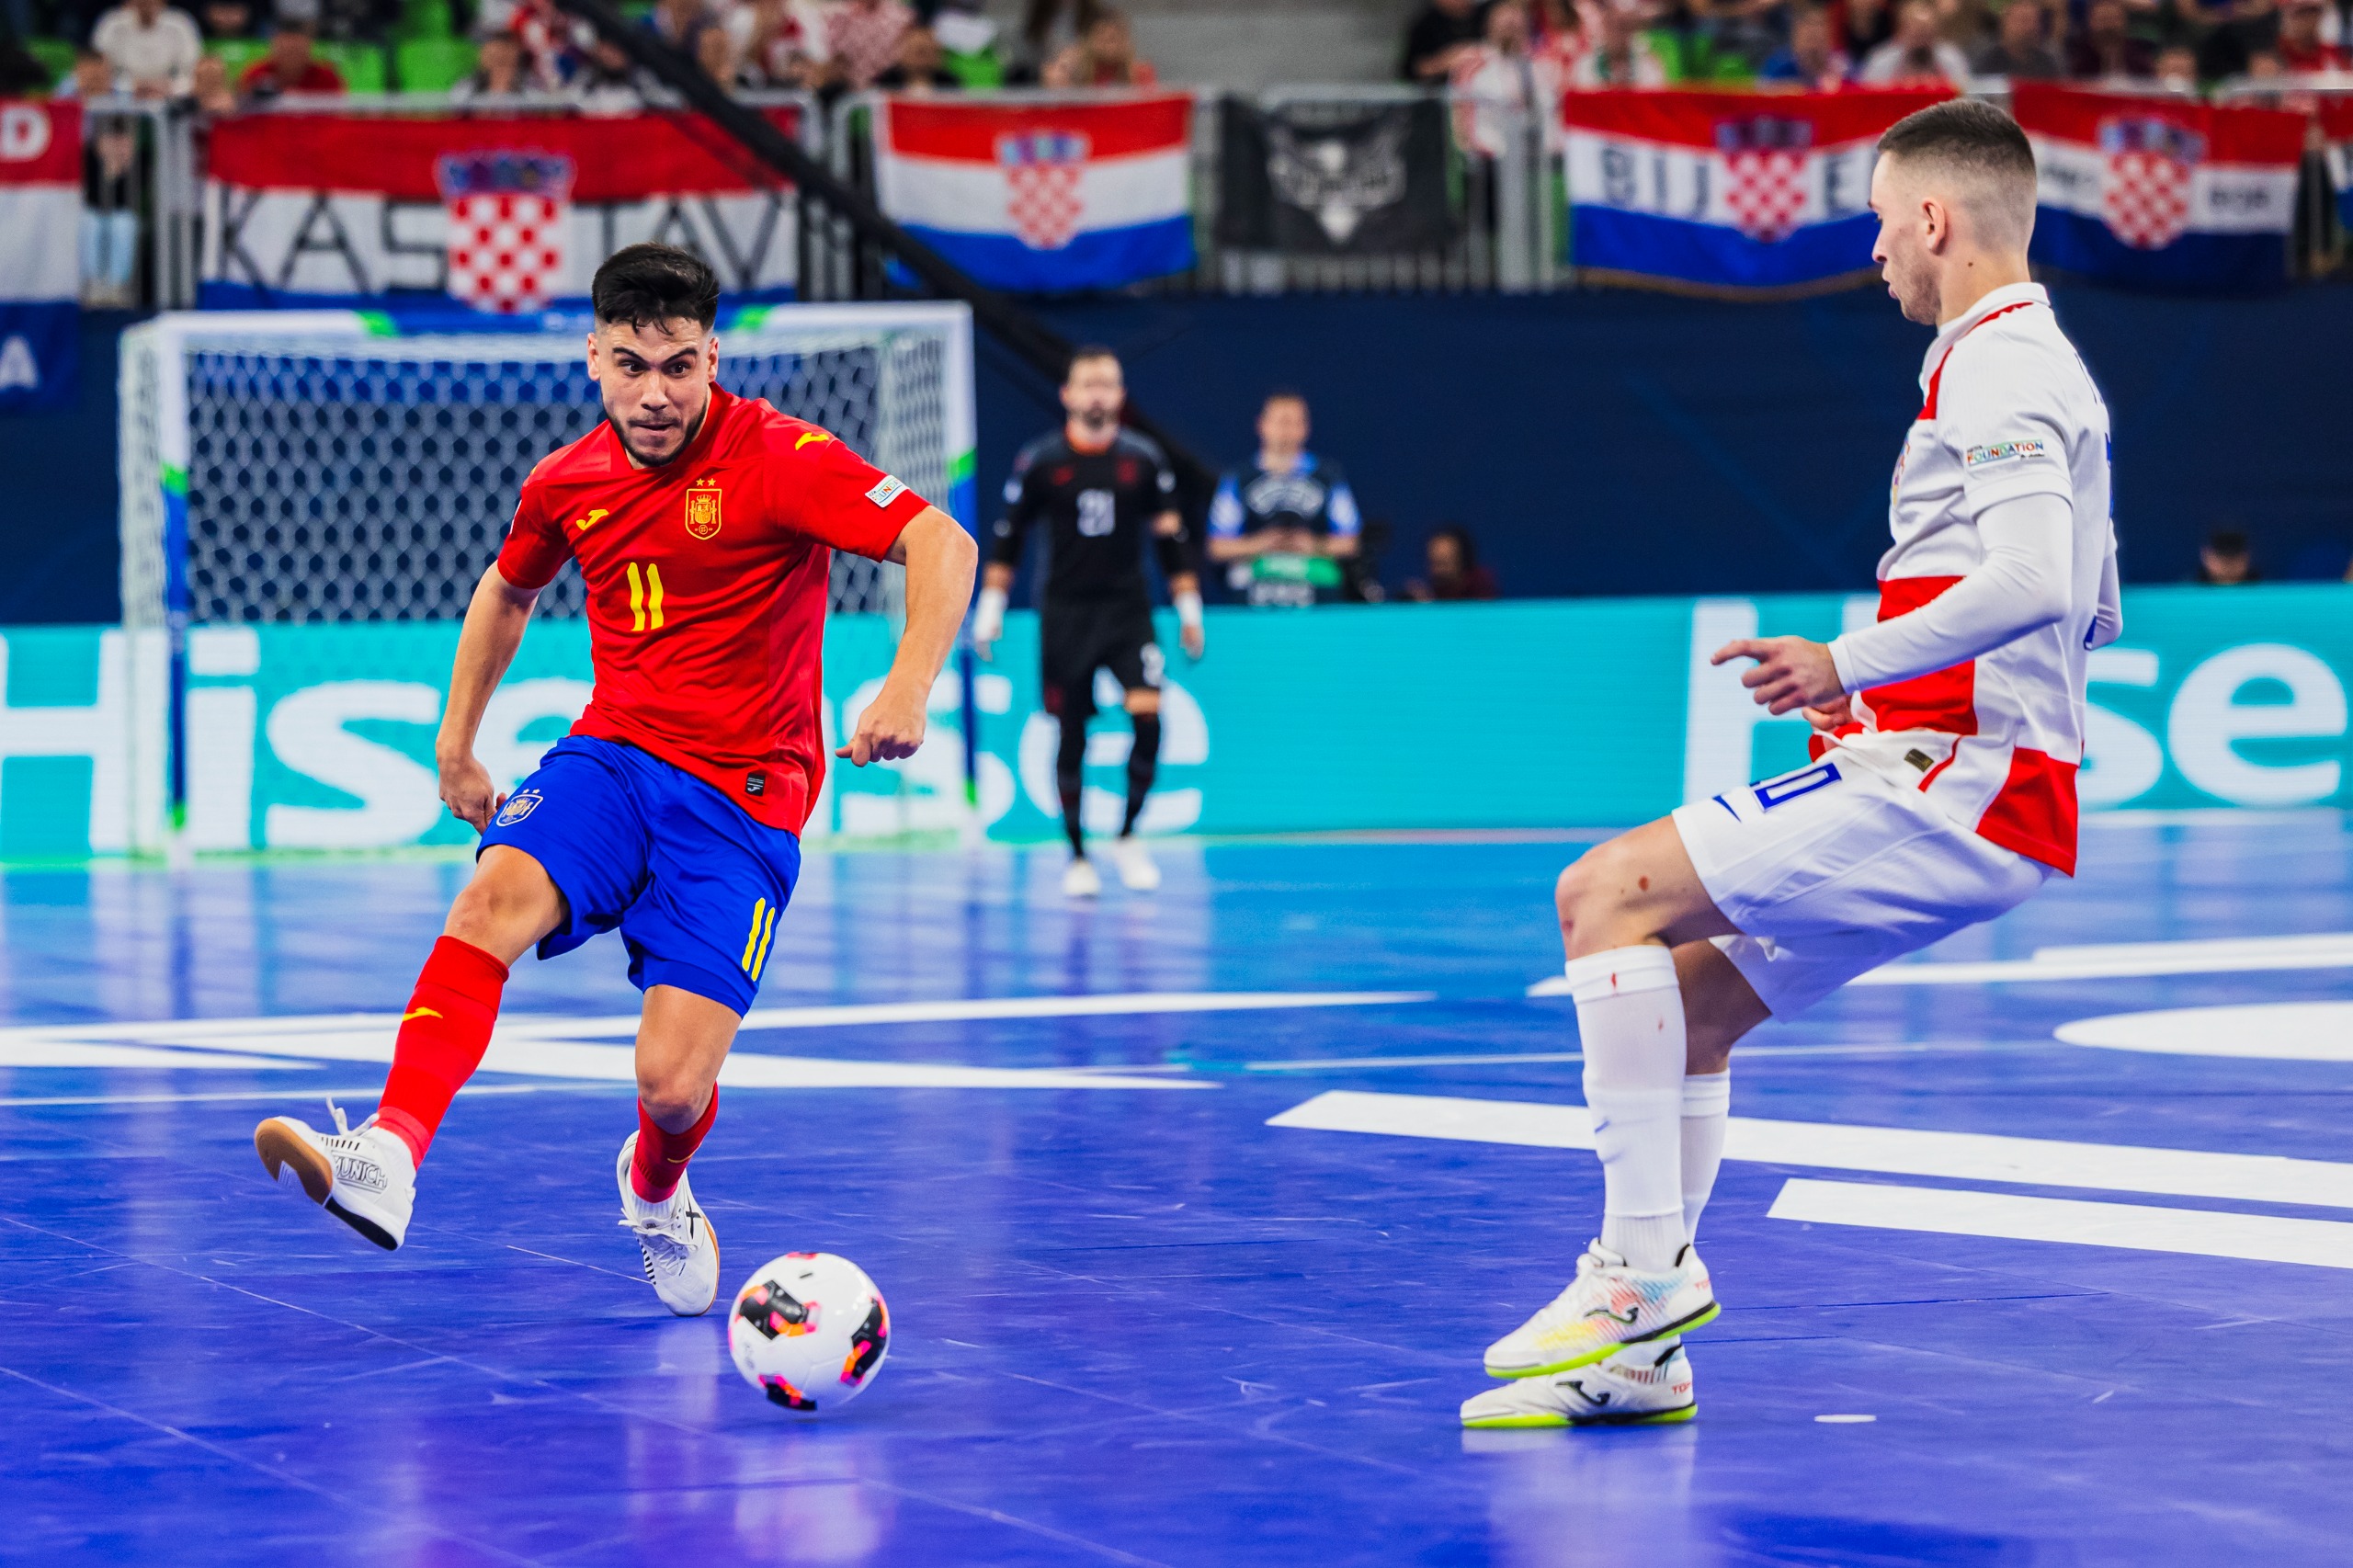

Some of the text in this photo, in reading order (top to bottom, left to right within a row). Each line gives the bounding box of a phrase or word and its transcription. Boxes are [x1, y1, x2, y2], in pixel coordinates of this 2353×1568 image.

[1967, 442, 2043, 464] FOUNDATION
[627, 562, 664, 631] 11
[742, 897, 776, 983] 11
